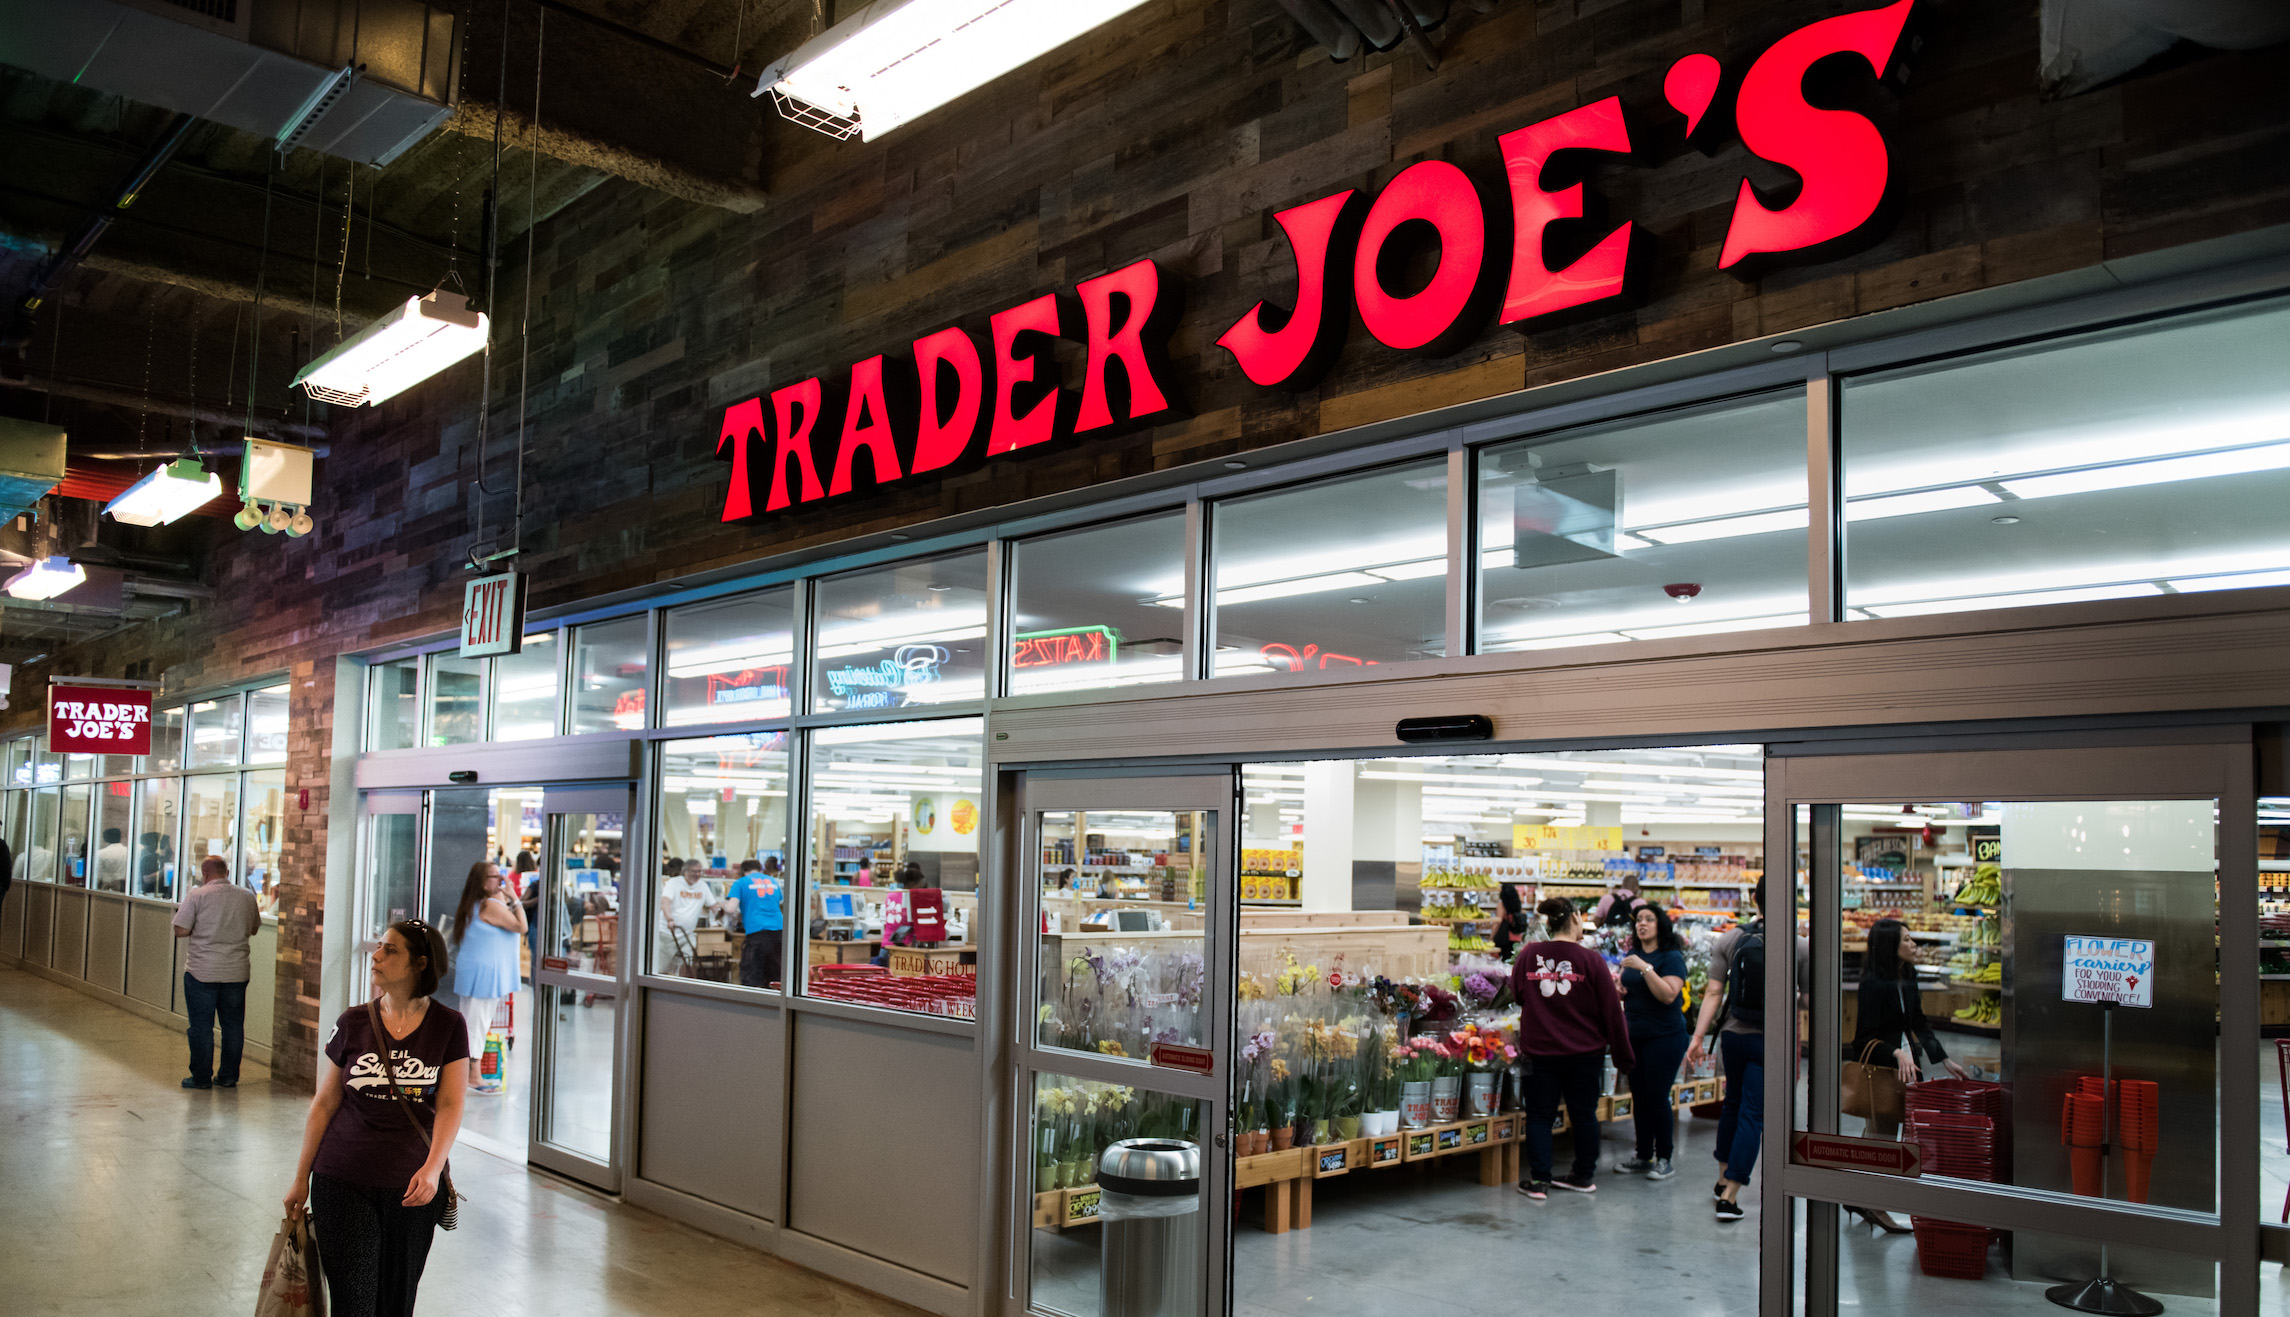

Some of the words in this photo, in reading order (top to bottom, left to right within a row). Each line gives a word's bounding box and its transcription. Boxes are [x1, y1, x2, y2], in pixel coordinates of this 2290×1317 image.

[716, 258, 1168, 523] TRADER
[1216, 0, 1914, 387] JOE'S
[468, 579, 508, 646] EXIT
[54, 701, 149, 722] TRADER
[65, 720, 136, 740] JOE'S
[2067, 938, 2147, 961] FLOWER
[894, 955, 943, 975] TRADING
[946, 960, 976, 978] HOU
[2066, 958, 2152, 976] carriers
[2075, 968, 2092, 979] FOR
[2096, 970, 2122, 981] YOUR
[2076, 979, 2121, 993] SHOPPING
[2074, 989, 2141, 1005] CONVENIENCE!
[946, 1001, 976, 1018] WEEK
[388, 1050, 411, 1060] EAL
[1813, 1145, 1849, 1159] AUTOMATIC
[1850, 1149, 1877, 1161] SLIDING
[1878, 1152, 1897, 1164] DOOR
